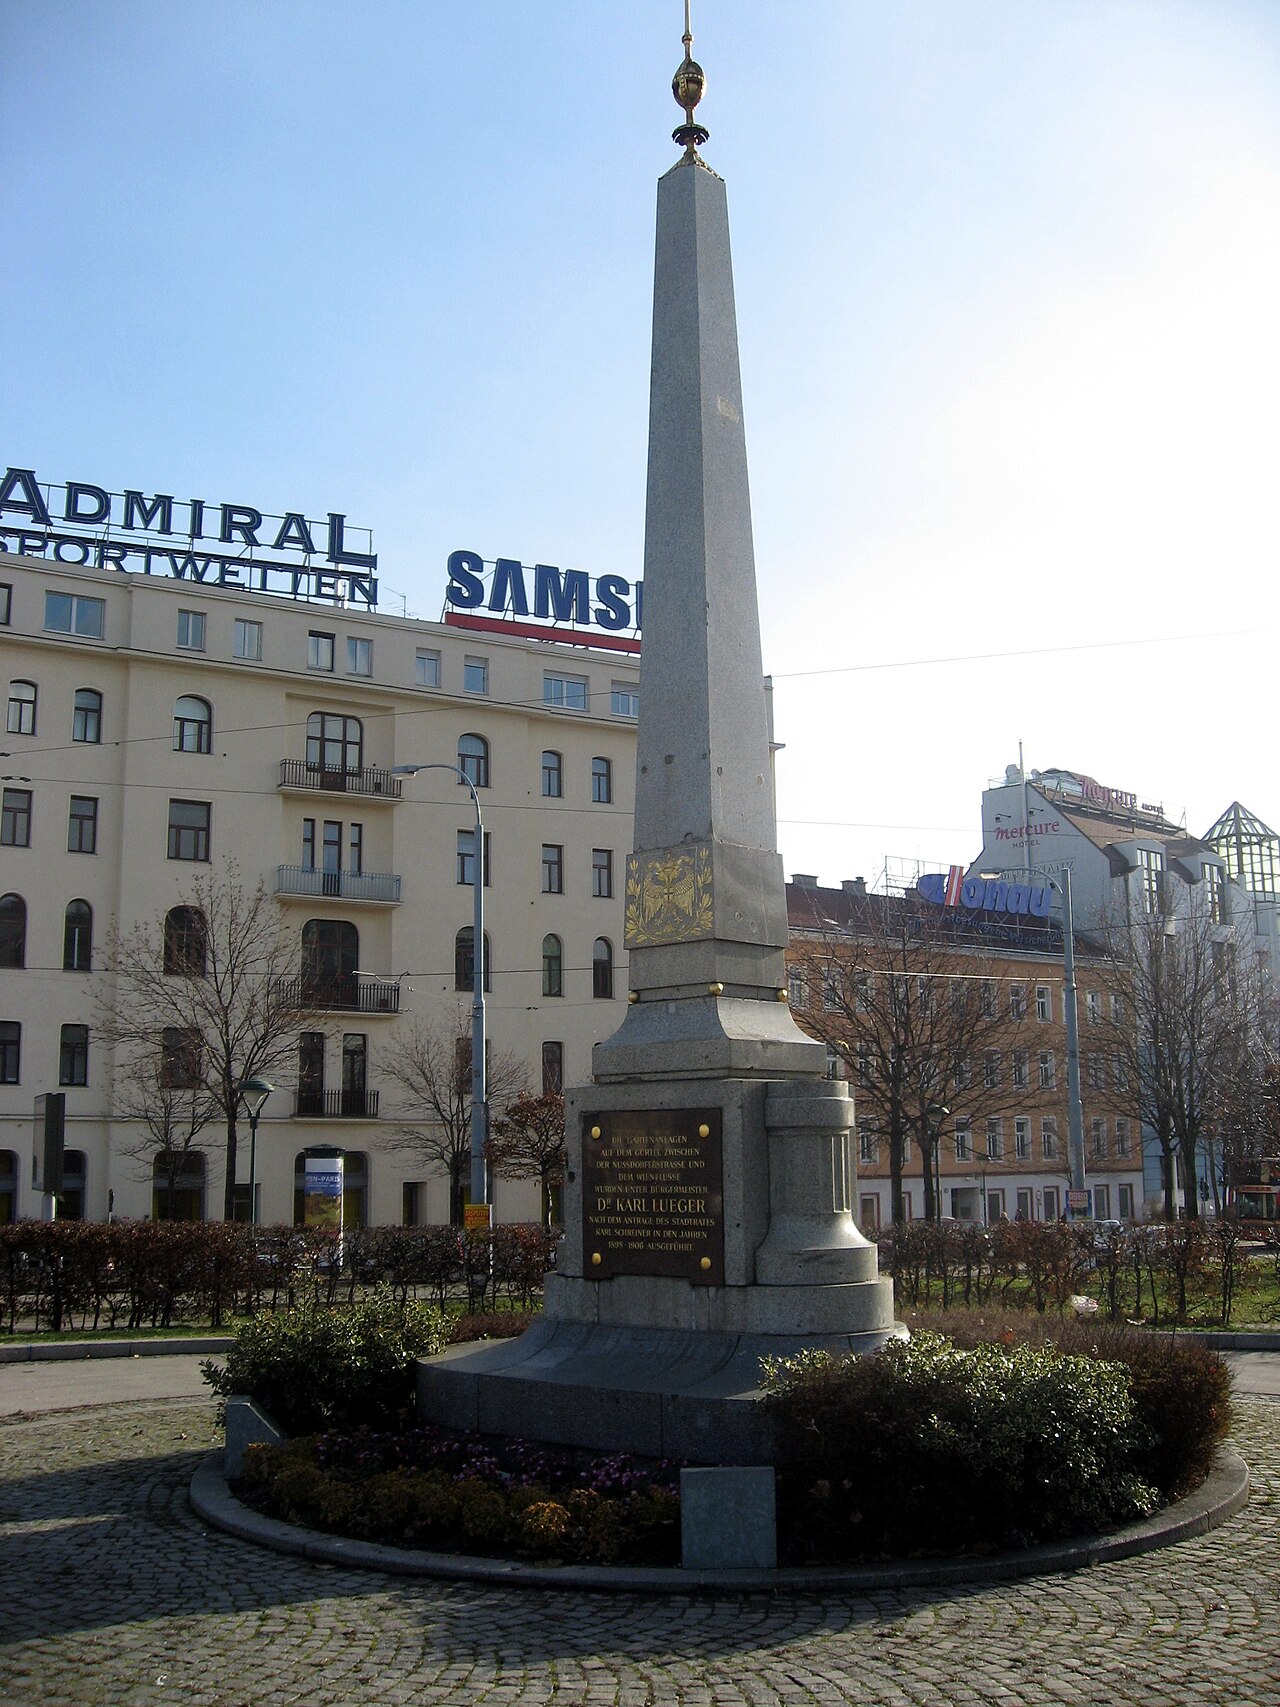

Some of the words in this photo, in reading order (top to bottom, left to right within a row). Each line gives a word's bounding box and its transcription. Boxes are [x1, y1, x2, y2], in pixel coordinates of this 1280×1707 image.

[0, 466, 378, 570] ADMIRAL
[446, 549, 644, 631] SAMS
[664, 1148, 700, 1156] ZWISCHEN
[596, 1161, 609, 1169] DER
[618, 1173, 633, 1181] DEM
[594, 1185, 623, 1194] WURDEN
[625, 1185, 648, 1194] UNTER
[616, 1198, 649, 1212] KARL
[652, 1198, 706, 1214] LUEGER
[588, 1216, 606, 1224] NACH
[607, 1216, 622, 1224] DEM
[655, 1217, 670, 1226] DES
[595, 1228, 612, 1236] KARL
[653, 1229, 661, 1238] IN
[663, 1230, 677, 1238] DEN
[679, 1230, 708, 1239] JAHREN
[628, 1241, 644, 1250] 1906
